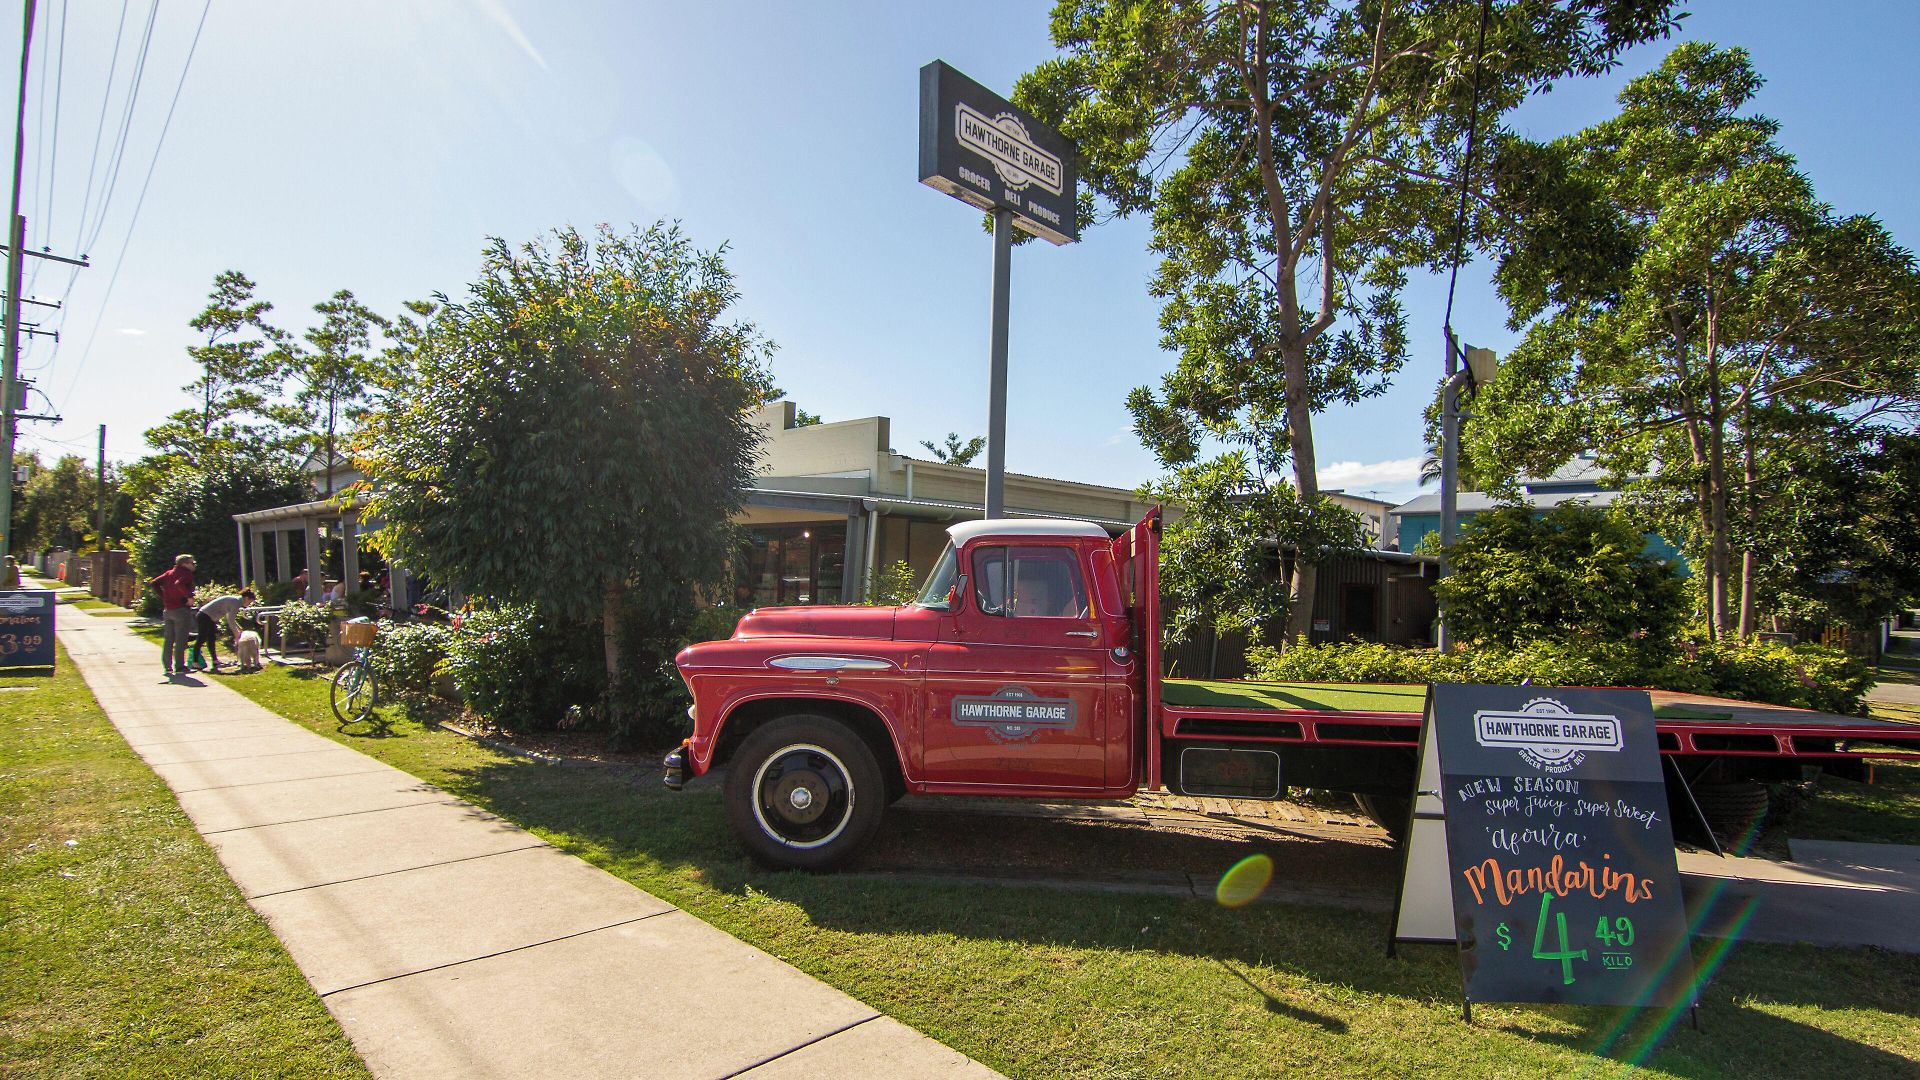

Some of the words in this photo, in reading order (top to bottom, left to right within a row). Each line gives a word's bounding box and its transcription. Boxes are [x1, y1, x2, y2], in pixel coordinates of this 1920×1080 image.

[965, 120, 1020, 162] HAWTHORNE
[1022, 151, 1056, 181] GARAGE
[959, 167, 991, 191] GROCER
[1005, 189, 1021, 206] DELI
[1028, 201, 1060, 225] PRODUCE
[961, 704, 1022, 718] HAWTHORNE
[1026, 706, 1066, 719] GARAGE
[1486, 721, 1559, 738] HAWTHORNE
[1563, 724, 1611, 740] GARAGE
[1518, 749, 1541, 770] GROCER
[1545, 763, 1573, 773] PRODUCE
[1573, 752, 1586, 766] DELI
[1458, 777, 1501, 801] NEW
[1514, 776, 1579, 794] SEASON
[1614, 799, 1662, 830] Sweet
[1463, 853, 1655, 906] Mandarins
[1532, 892, 1589, 984] 4
[1595, 916, 1635, 947] 49
[1602, 956, 1633, 967] KILO
